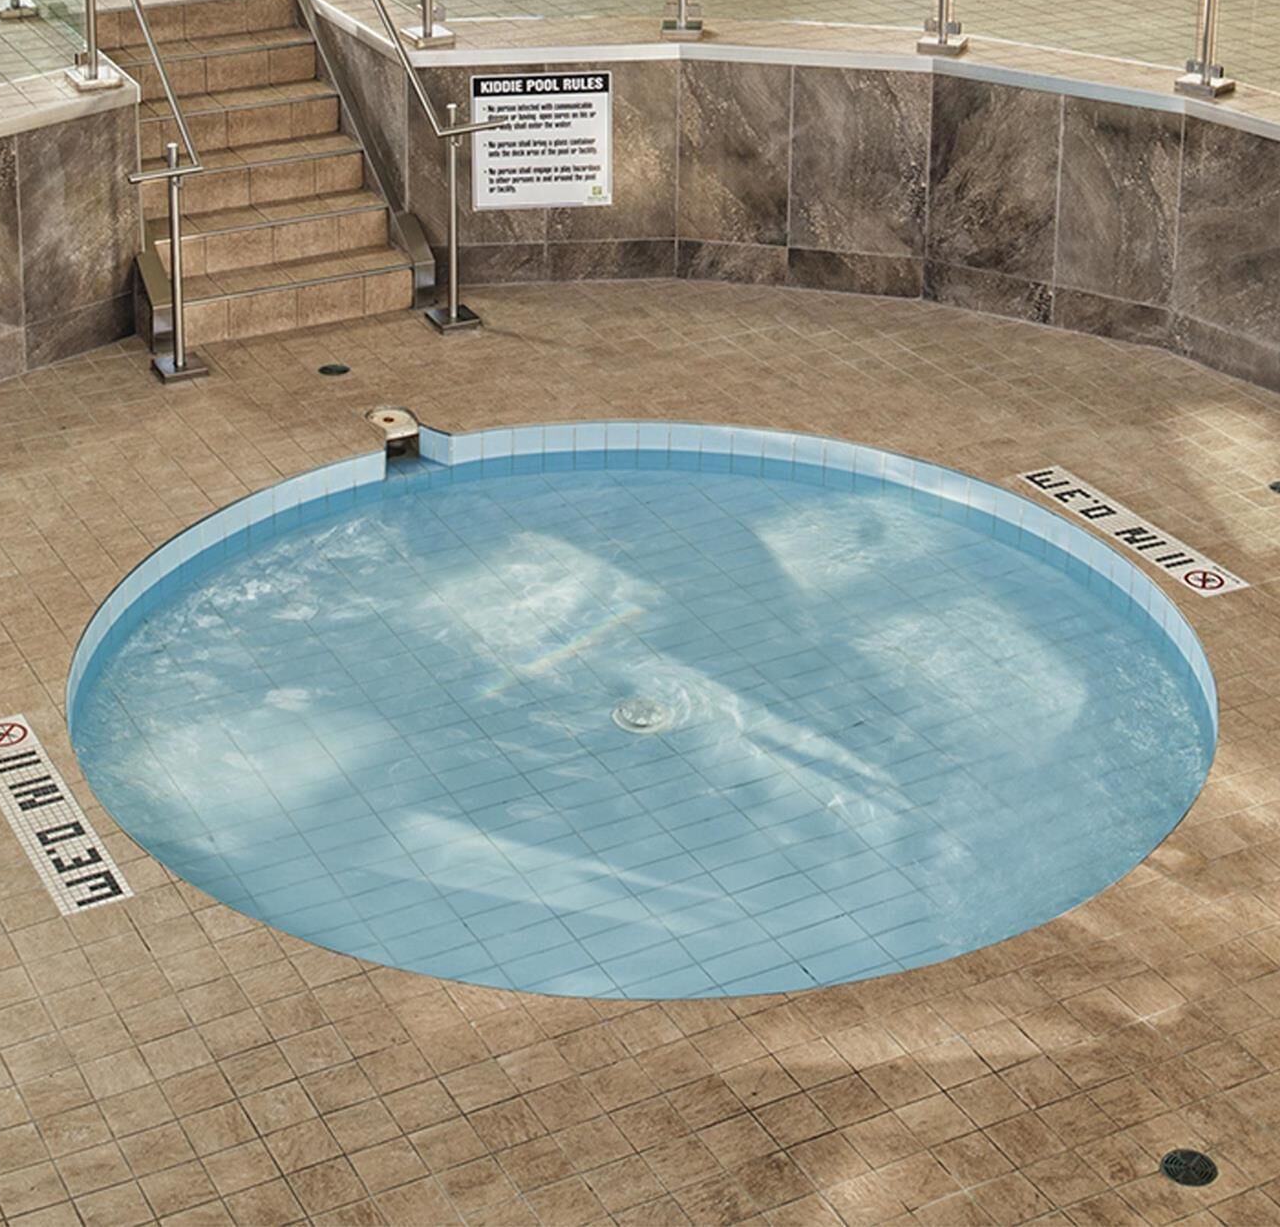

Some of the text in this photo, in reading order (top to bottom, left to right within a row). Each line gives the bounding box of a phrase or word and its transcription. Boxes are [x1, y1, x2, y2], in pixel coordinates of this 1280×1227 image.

[480, 77, 603, 93] KIDDIE POOL RULES
[1114, 526, 1167, 551] IN
[8, 774, 65, 812] IN
[35, 820, 123, 907] 0.3M
